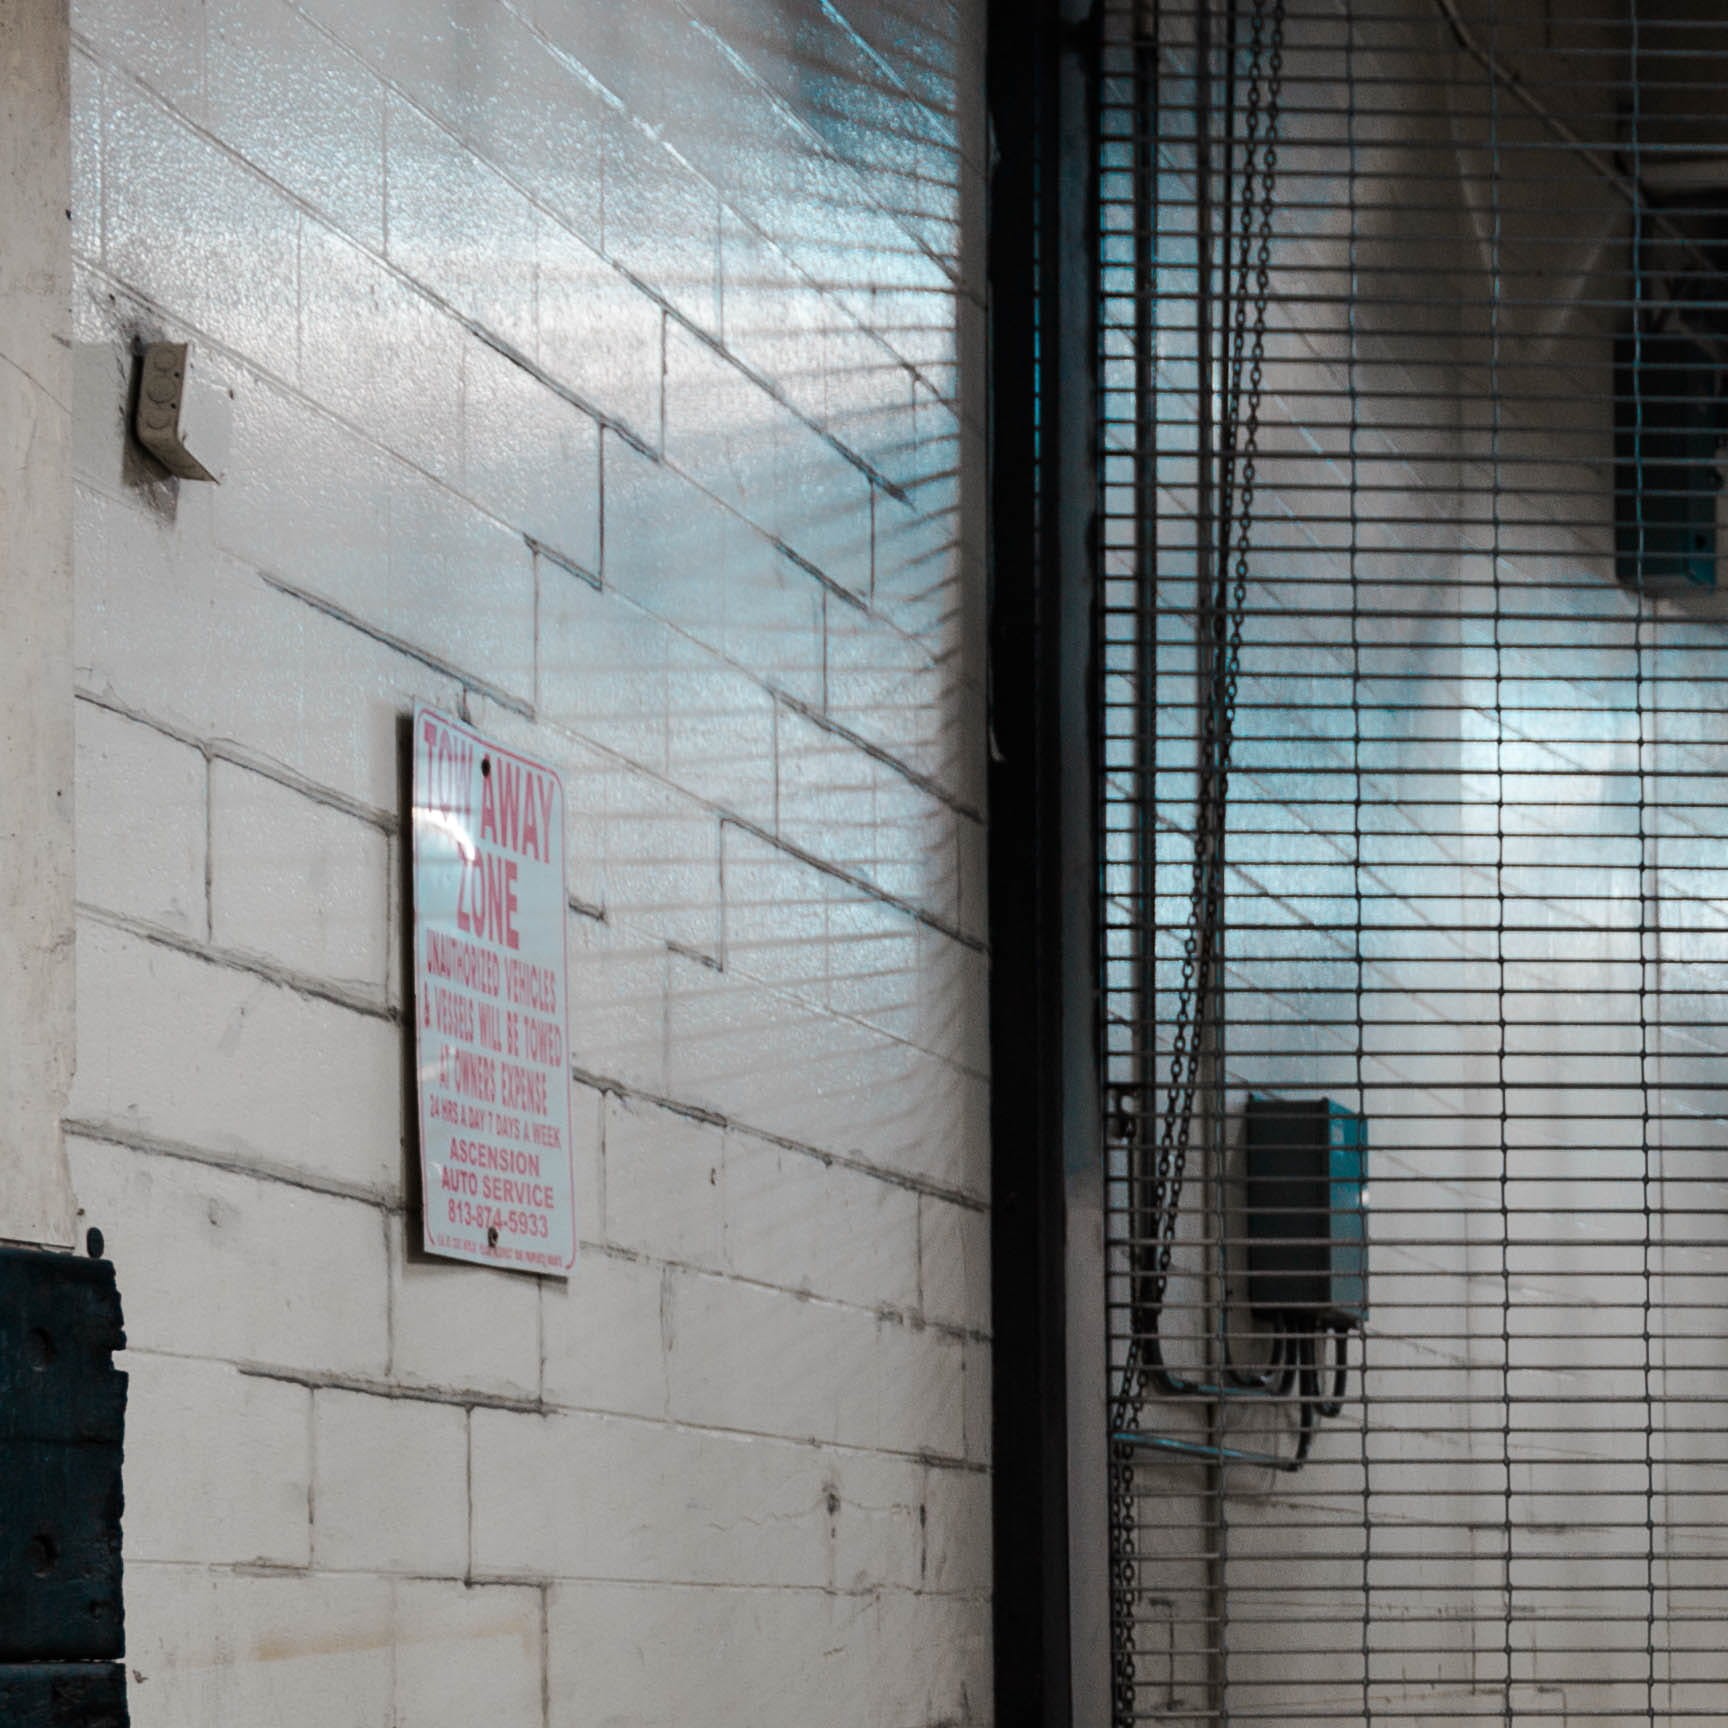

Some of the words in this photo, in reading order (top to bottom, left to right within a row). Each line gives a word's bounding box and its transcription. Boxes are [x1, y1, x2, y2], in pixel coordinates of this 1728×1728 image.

[423, 720, 474, 822] TOW
[480, 753, 554, 864] AWAY
[456, 841, 519, 950] ZONE
[426, 928, 499, 997] UNAUTHORIZED
[505, 956, 556, 1014] VEHICLES
[434, 984, 474, 1043] VESSELS
[478, 1002, 502, 1052] WILL
[506, 1010, 519, 1057] BE
[523, 1015, 561, 1067] TOWED
[440, 1044, 449, 1089] AT
[455, 1048, 496, 1103] OWNERS
[502, 1061, 547, 1116] EXPENSE
[430, 1094, 440, 1118] 24
[442, 1098, 458, 1124] HRS
[460, 1104, 467, 1126] A
[468, 1106, 486, 1131] DAY
[487, 1111, 493, 1134] 7
[496, 1113, 520, 1141] DAYS
[523, 1120, 530, 1143] A
[532, 1123, 561, 1148] WEEK
[450, 1136, 540, 1177] ASCENSION
[441, 1165, 478, 1196] AUTO
[482, 1176, 554, 1209] SERVICE
[448, 1199, 548, 1238] 813-874-5933
